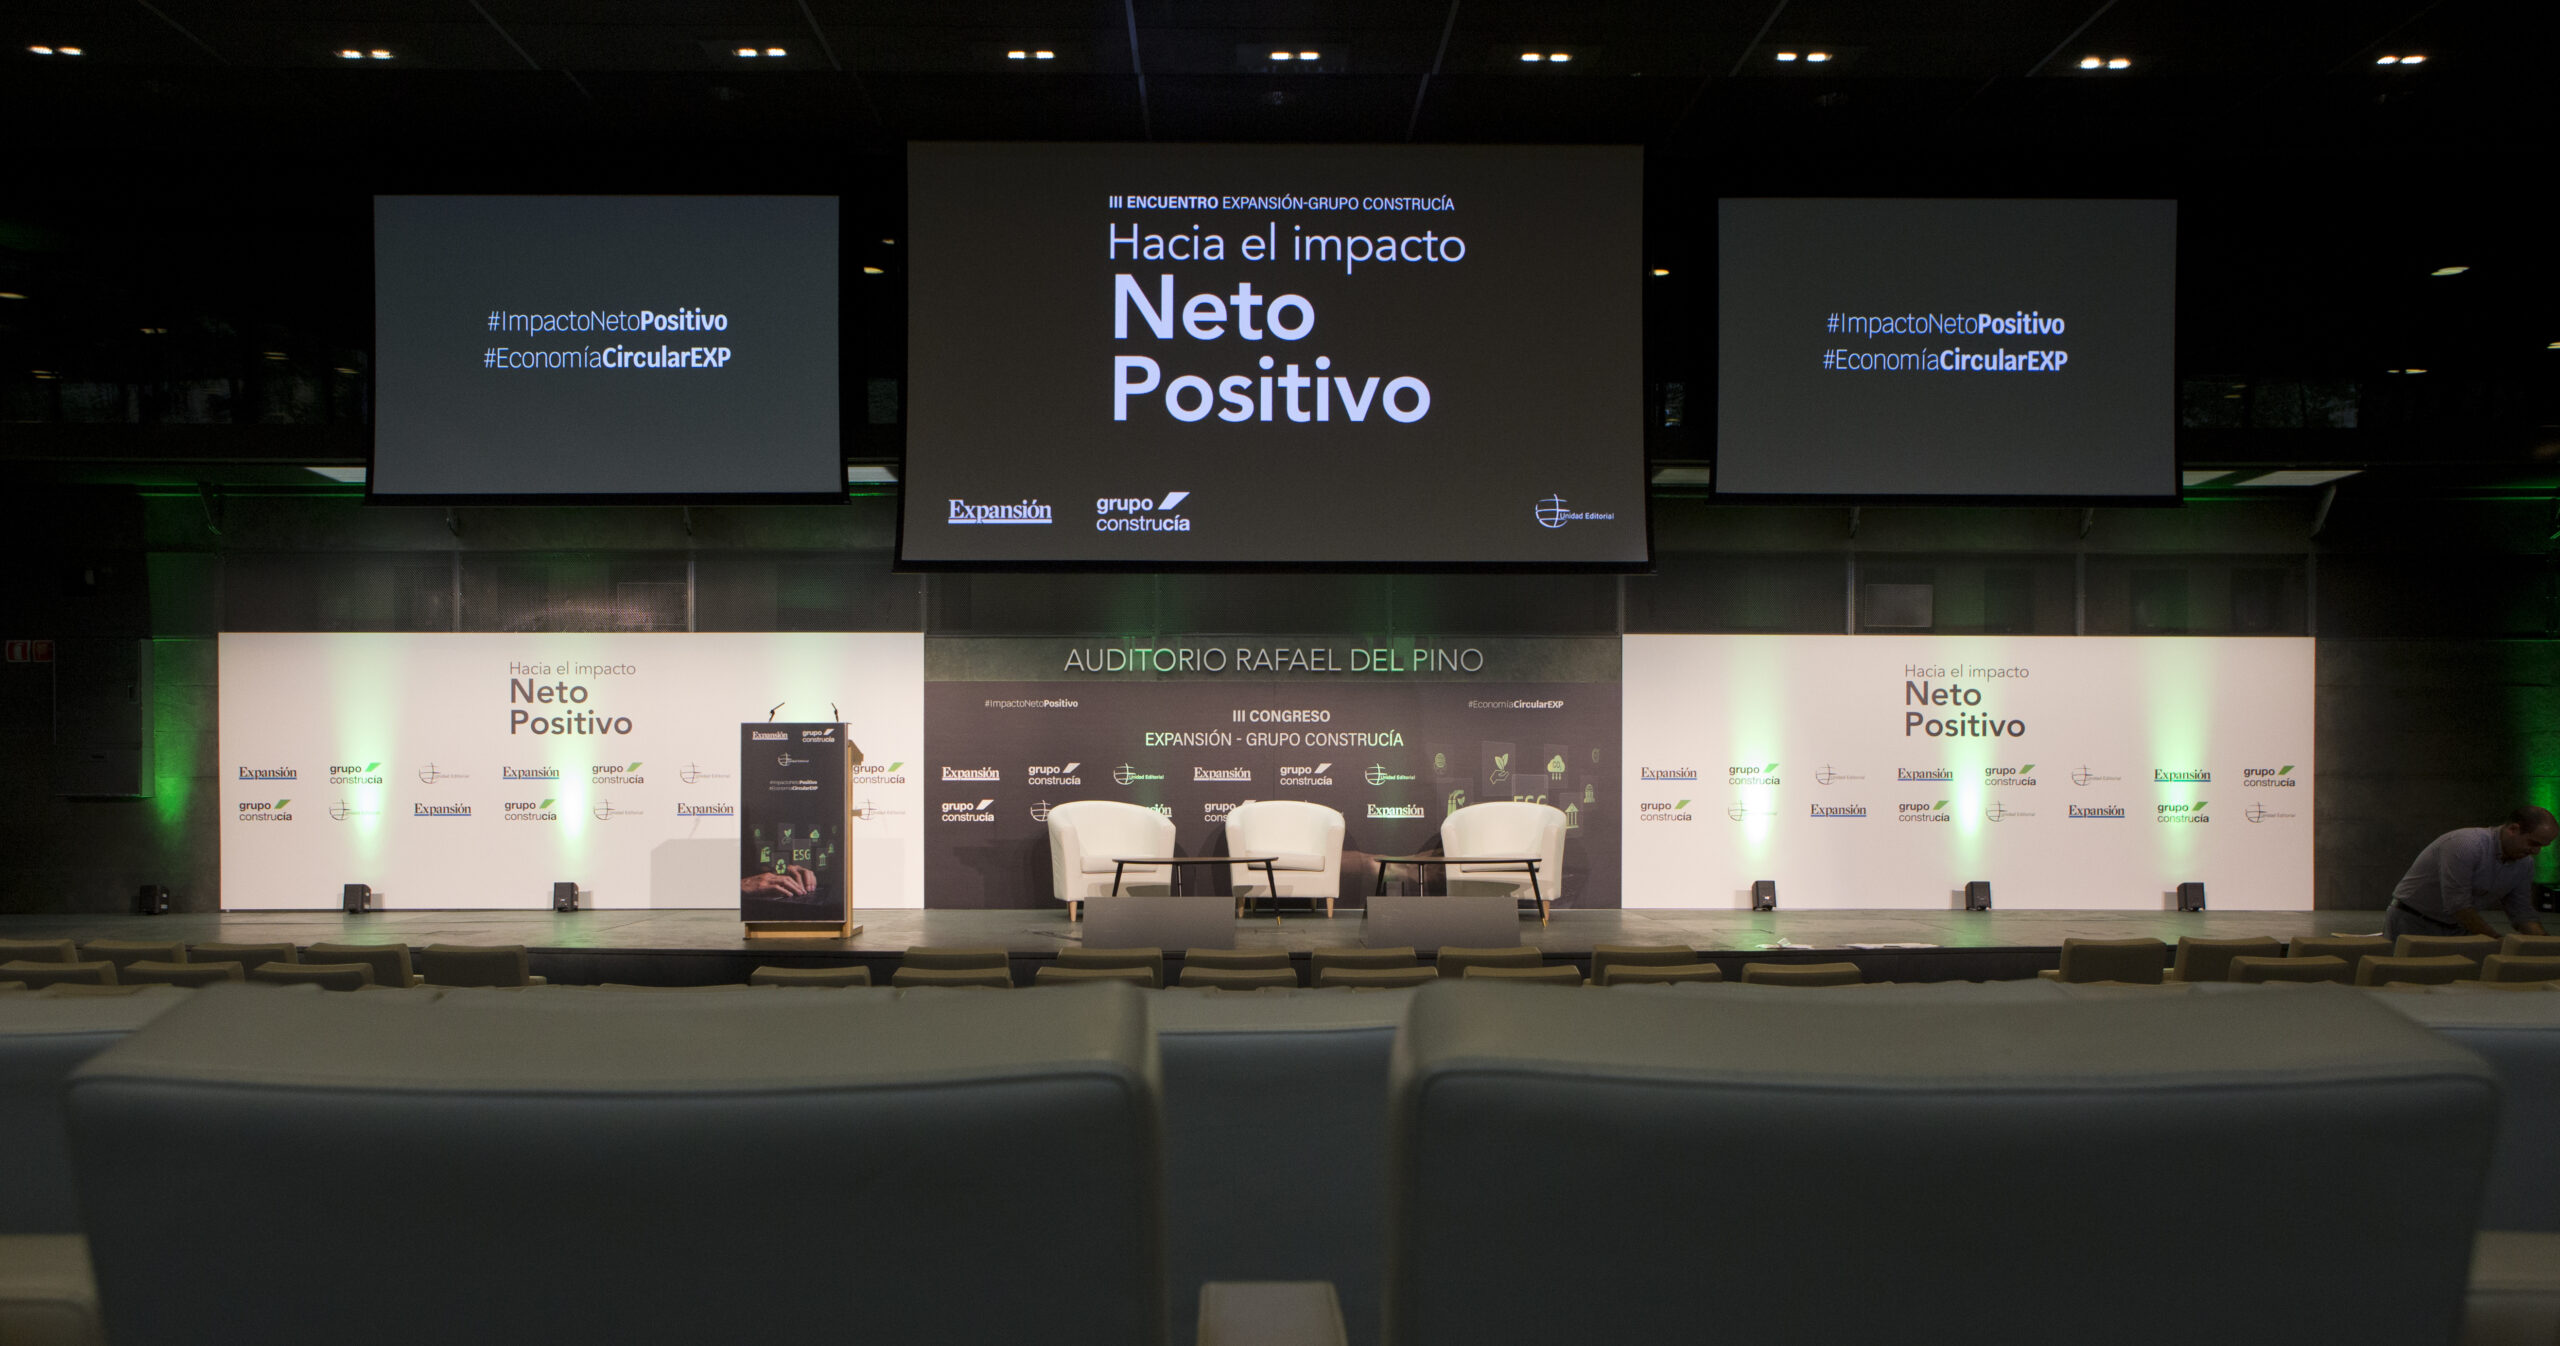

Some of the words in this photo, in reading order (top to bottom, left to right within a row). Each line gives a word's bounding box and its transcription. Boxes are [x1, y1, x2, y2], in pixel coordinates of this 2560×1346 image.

[1109, 196, 1122, 209] III
[1127, 196, 1219, 209] ENCUENTRO
[1222, 194, 1359, 211] EXPANSIÓN-GRUPO
[1363, 194, 1455, 211] CONSTRUCÍA
[1109, 222, 1225, 261] Hacia
[1241, 221, 1276, 262] el
[1294, 224, 1466, 275] impacto
[1114, 273, 1315, 341] Neto
[487, 307, 728, 337] #ImpactoNetoPositivo
[1827, 311, 2065, 339] #ImpactoNetoPositivo
[484, 344, 732, 369] #EconomíaCircularEXP
[1823, 346, 2068, 372] #EconomíaCircularEXP
[1114, 355, 1431, 423] Positivo
[948, 499, 1052, 525] Expansión
[1096, 497, 1154, 515] grupo
[1096, 514, 1190, 532] construcía
[1560, 512, 1583, 520] Unidad
[1585, 512, 1614, 520] Editorial
[1064, 648, 1227, 672] AUDITORIO
[1236, 648, 1342, 673] RAFAEL
[1351, 648, 1404, 673] DEL
[1413, 648, 1484, 673] PINO
[509, 661, 553, 676] Hacia
[557, 661, 570, 676] el
[575, 662, 637, 680] impacto
[1905, 664, 1946, 678] Hacia
[1950, 663, 1963, 678] el
[1969, 664, 2029, 682] impacto
[510, 678, 589, 704] Neto
[1905, 680, 1982, 706] Neto
[985, 698, 1079, 710] #ImpactoNetoPositivo
[510, 709, 633, 735] Positivo
[1232, 710, 1246, 723] III
[1249, 710, 1331, 723] CONGRESO
[1905, 711, 2026, 737] Positivo
[1145, 729, 1232, 747] EXPANSIÓN
[1246, 733, 1301, 747] GRUPO
[1305, 729, 1404, 747] CONSTRUCÍA
[239, 766, 297, 780] Expansión
[329, 765, 362, 775] grupo
[502, 766, 560, 780] Expansión
[592, 764, 624, 775] grupo
[853, 765, 884, 775] grupo
[942, 766, 1000, 781] Expansión
[1028, 765, 1060, 776] grupo
[1194, 766, 1251, 781] Expansión
[1280, 765, 1312, 776] grupo
[1640, 767, 1697, 781] Expansión
[1729, 765, 1760, 775] grupo
[1897, 768, 1954, 781] Expansión
[1985, 766, 2016, 776] grupo
[2154, 768, 2211, 782] Expansión
[2243, 767, 2275, 777] grupo
[239, 801, 271, 811] grupo
[414, 803, 471, 817] Expansión
[504, 801, 536, 811] grupo
[677, 802, 734, 816] Expansión
[942, 801, 974, 812] grupo
[1204, 802, 1237, 813] grupo
[1367, 804, 1425, 818] Expansión
[1640, 802, 1671, 812] grupo
[1810, 804, 1867, 817] Expansión
[1899, 802, 1930, 812] grupo
[2069, 805, 2125, 818] Expansión
[2157, 803, 2189, 814] grupo
[793, 849, 811, 861] ESG
